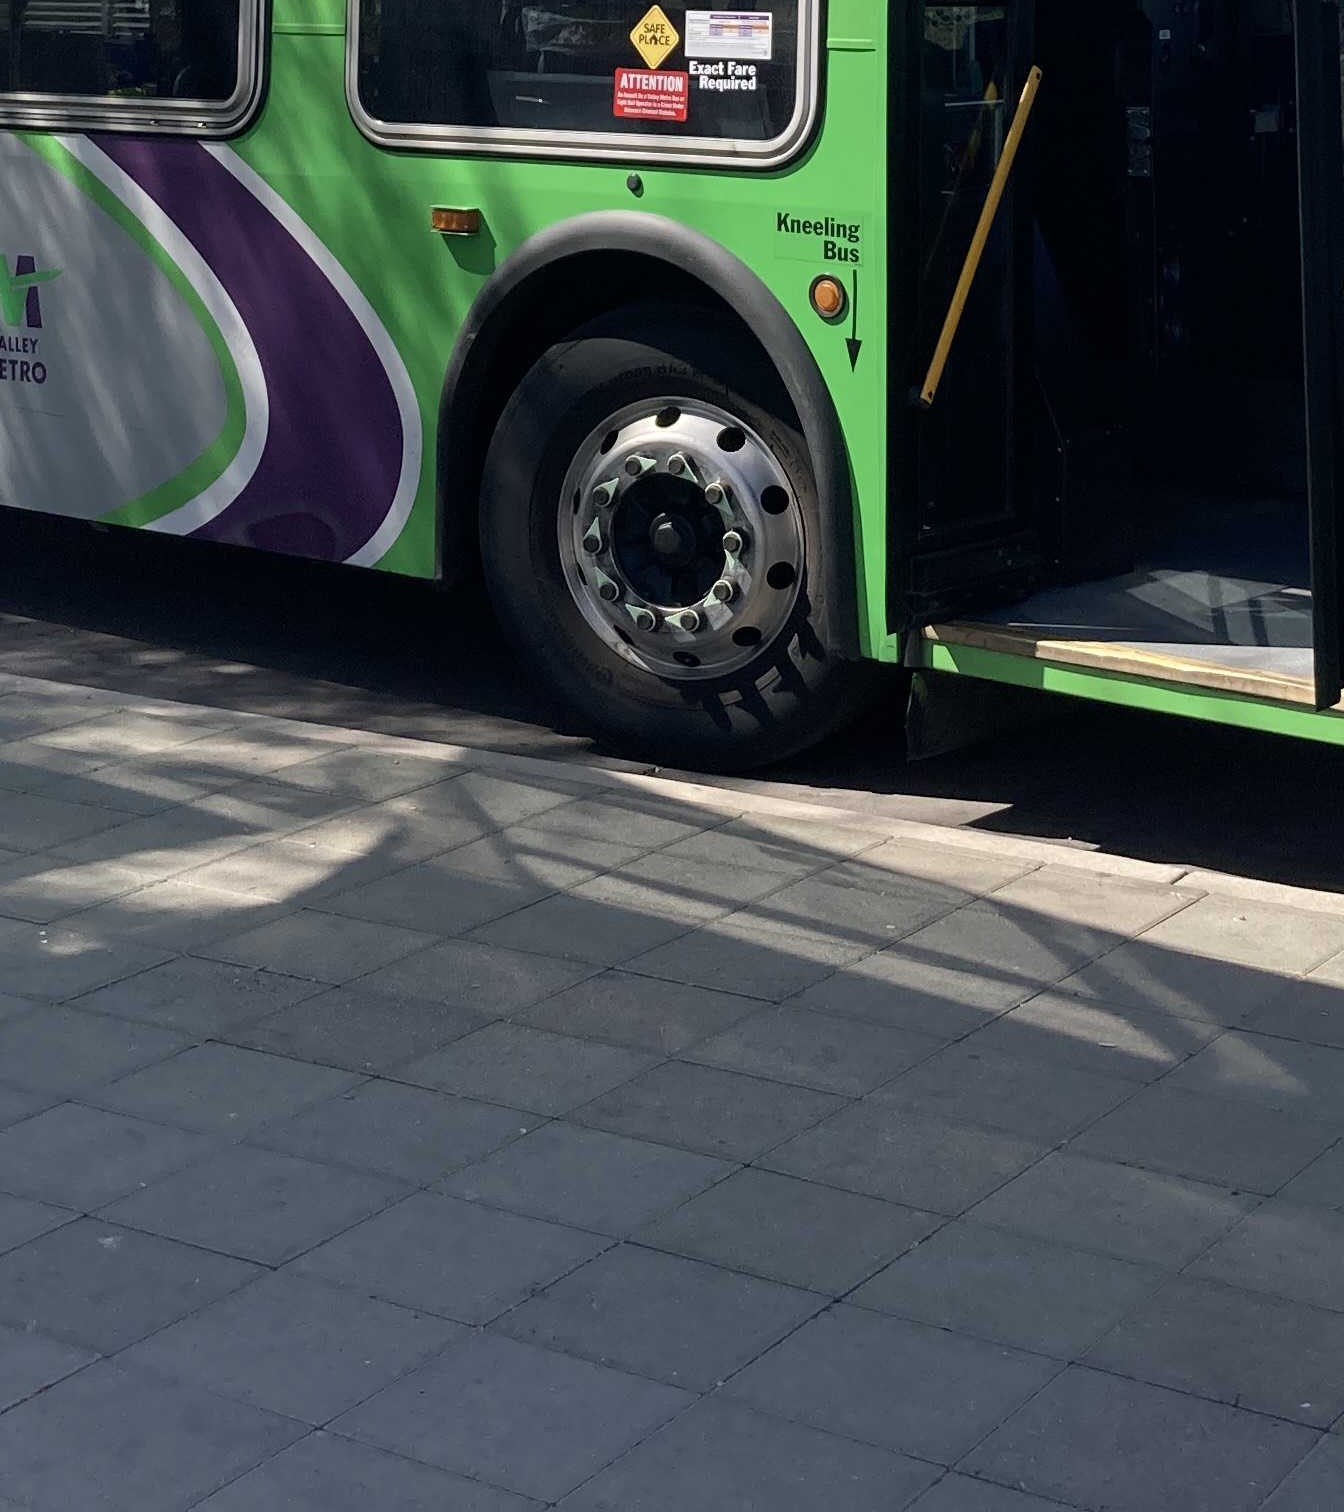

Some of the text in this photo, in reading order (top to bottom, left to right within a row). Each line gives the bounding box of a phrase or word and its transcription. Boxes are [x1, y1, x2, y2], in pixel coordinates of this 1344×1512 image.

[644, 23, 665, 33] SAFE
[689, 61, 756, 76] Exact Fare
[620, 73, 683, 92] ATTENTION
[699, 74, 756, 92] Required
[776, 212, 860, 243] Kneeling
[824, 240, 860, 263] Bus
